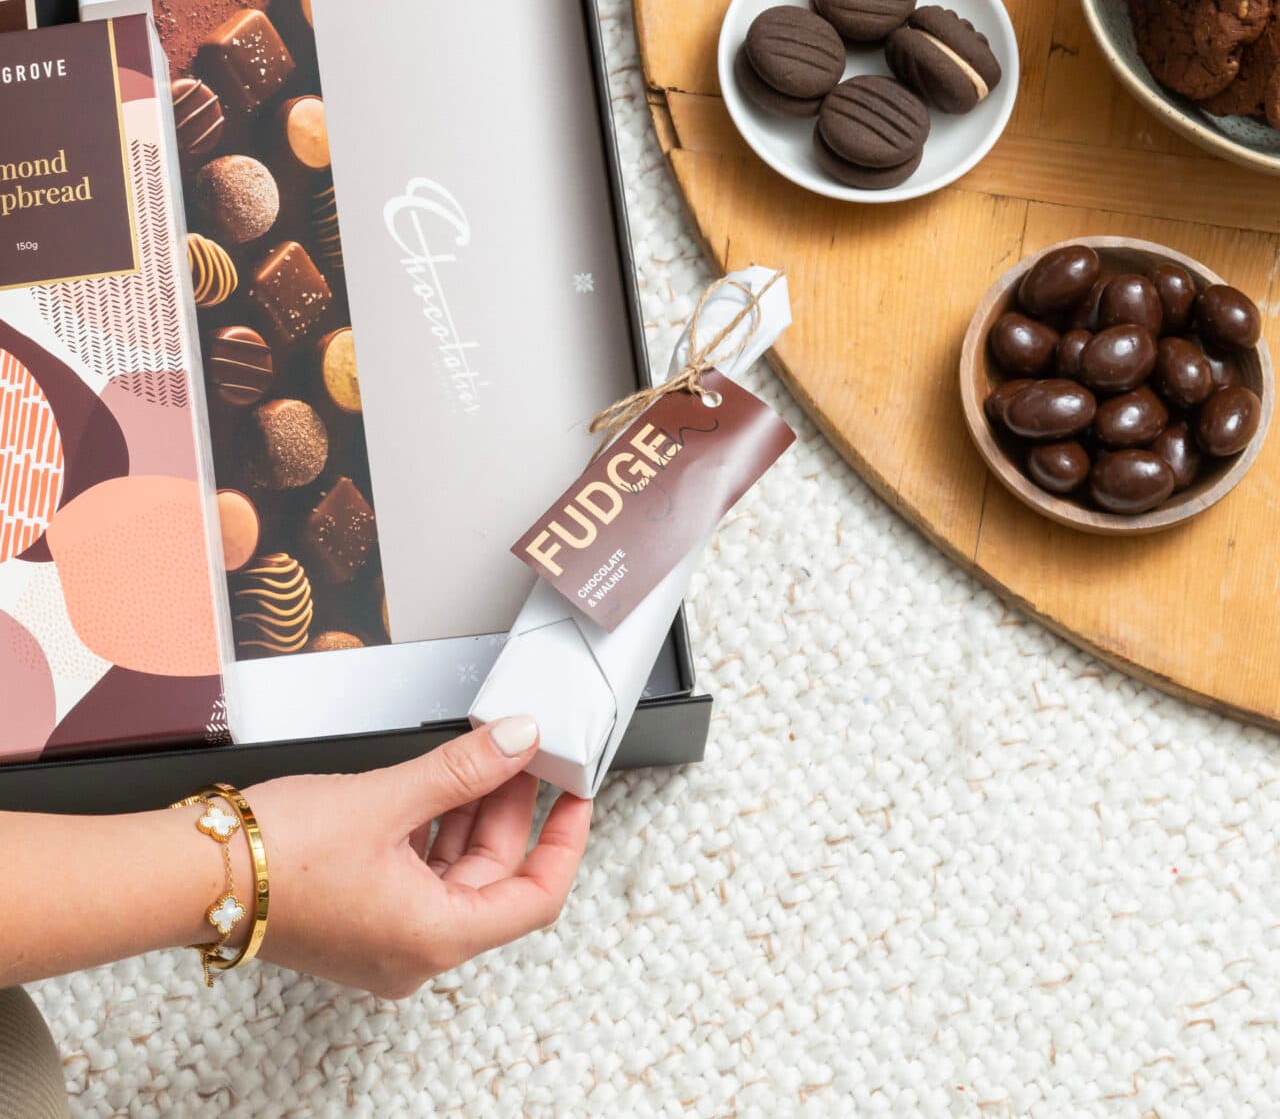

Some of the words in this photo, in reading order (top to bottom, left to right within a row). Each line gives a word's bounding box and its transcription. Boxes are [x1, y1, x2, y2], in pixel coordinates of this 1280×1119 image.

[16, 241, 39, 251] 150g
[526, 423, 682, 577] FUDGE
[577, 548, 627, 599] CHOCOLATE
[593, 564, 629, 603] WALNUT
